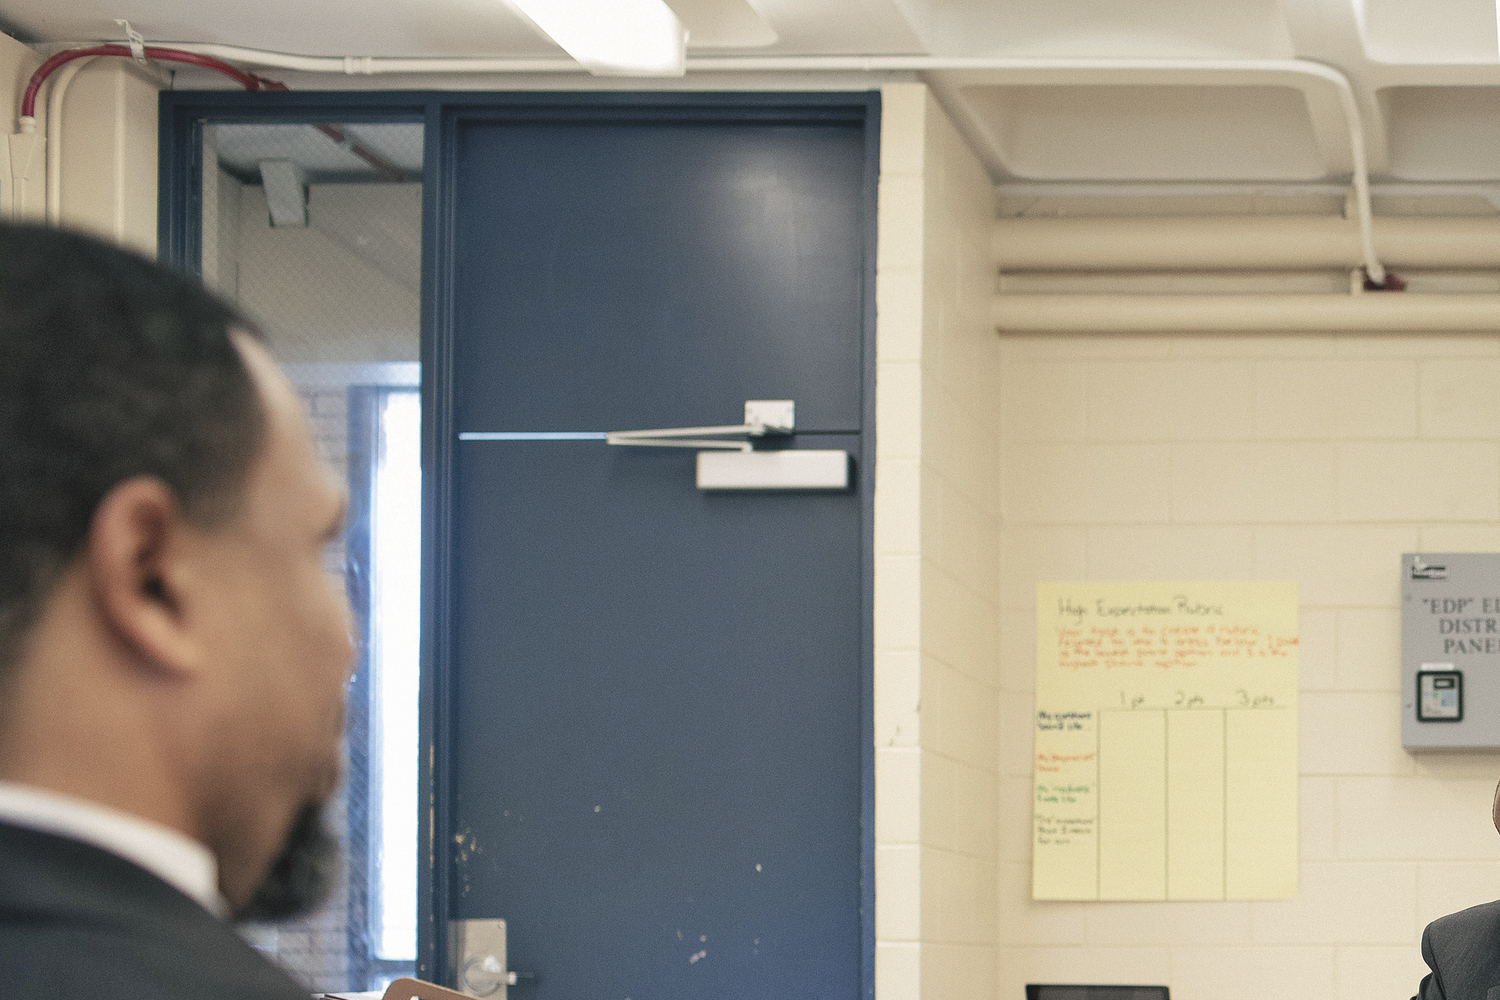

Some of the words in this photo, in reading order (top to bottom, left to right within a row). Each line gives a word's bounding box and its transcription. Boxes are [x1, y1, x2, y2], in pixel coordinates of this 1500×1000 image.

[1421, 597, 1474, 614] "EDP"
[1174, 690, 1186, 706] 2
[1235, 688, 1250, 707] 3
